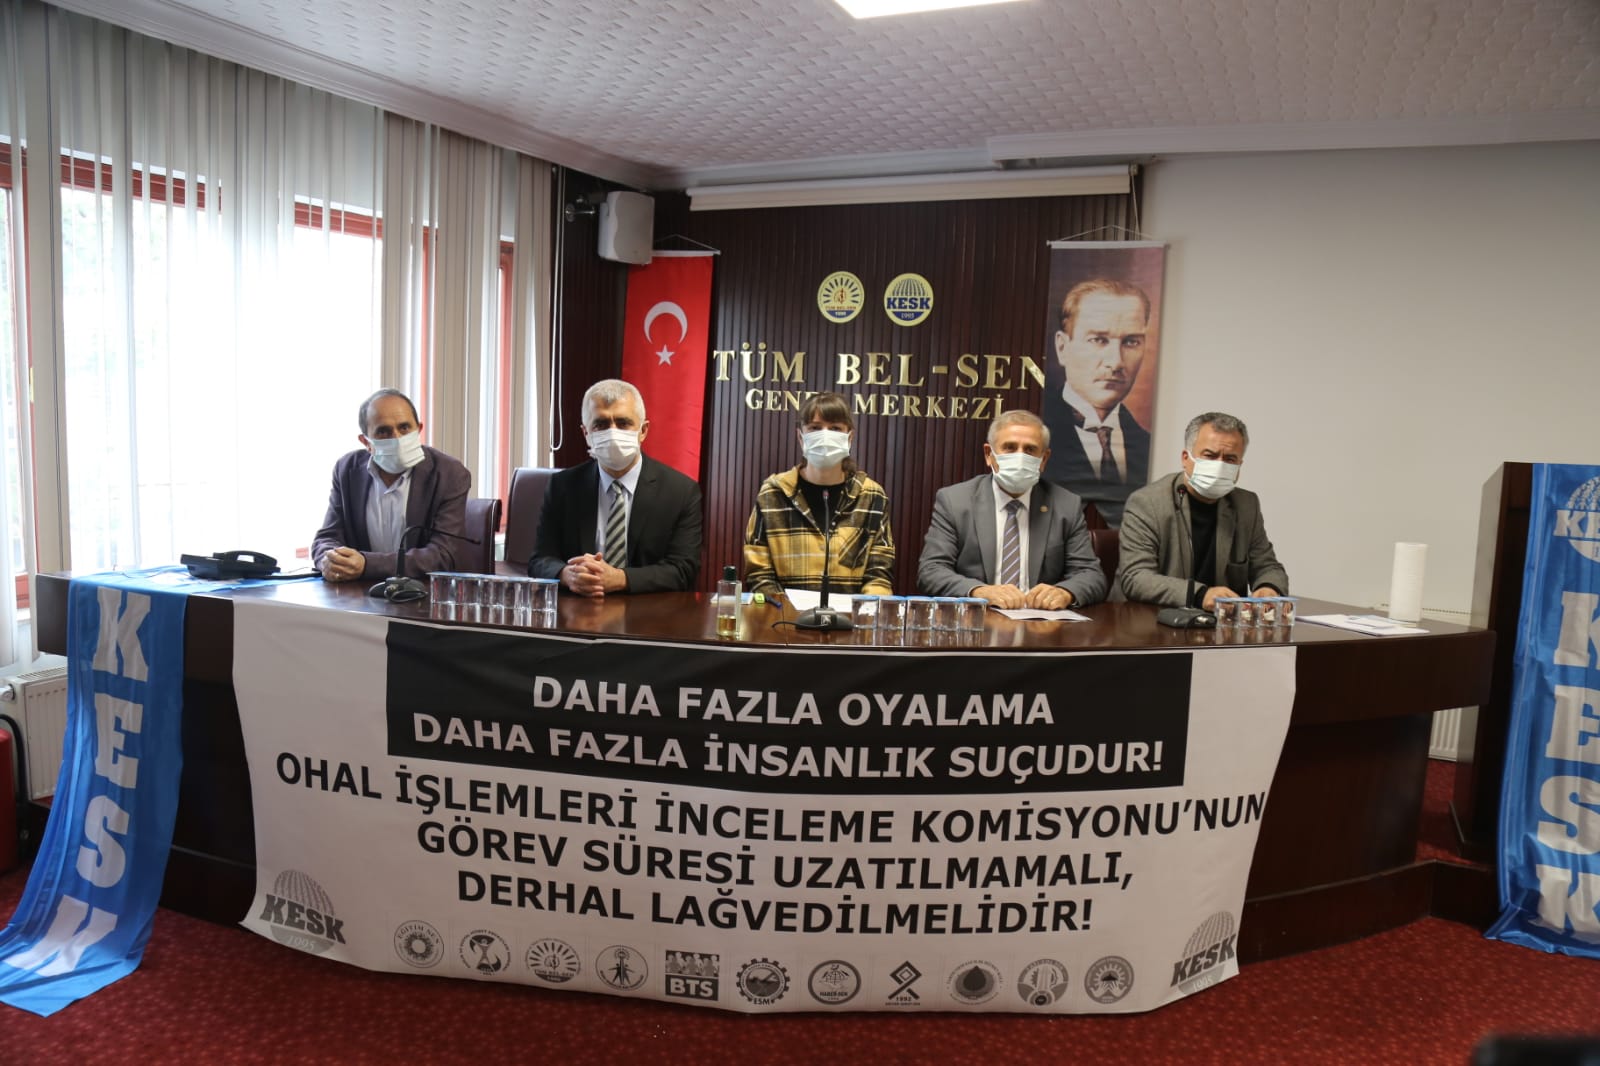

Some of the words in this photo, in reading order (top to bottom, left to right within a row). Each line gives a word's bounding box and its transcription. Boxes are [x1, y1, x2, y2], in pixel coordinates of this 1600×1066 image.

[887, 297, 931, 310] KESK
[713, 342, 806, 383] TÜM
[745, 388, 820, 411] GEN
[853, 394, 1004, 419] MERKEZİ
[533, 675, 661, 718] DAHA
[678, 686, 823, 726] FAZLA
[838, 693, 1055, 727] OYALAMA
[413, 712, 535, 755] DAHA
[548, 728, 689, 769] FAZLA
[703, 733, 935, 778] İNSANLIK
[948, 741, 1164, 784] SUÇUDUR!
[276, 752, 383, 800] OHAL
[395, 764, 638, 830] İŞLEMLERİ
[654, 791, 895, 843] İNCELEME
[417, 816, 568, 867] GÖREV
[582, 834, 756, 886] SÜRESİ
[774, 851, 1134, 890] UZATILMAMALI,
[260, 894, 346, 945] KESK
[458, 870, 635, 920] DERHAL
[651, 888, 1093, 936] LAĞVEDİLMELİDİR!
[286, 934, 316, 952] 1995
[1170, 933, 1237, 988] KESK
[670, 978, 713, 998] BTS
